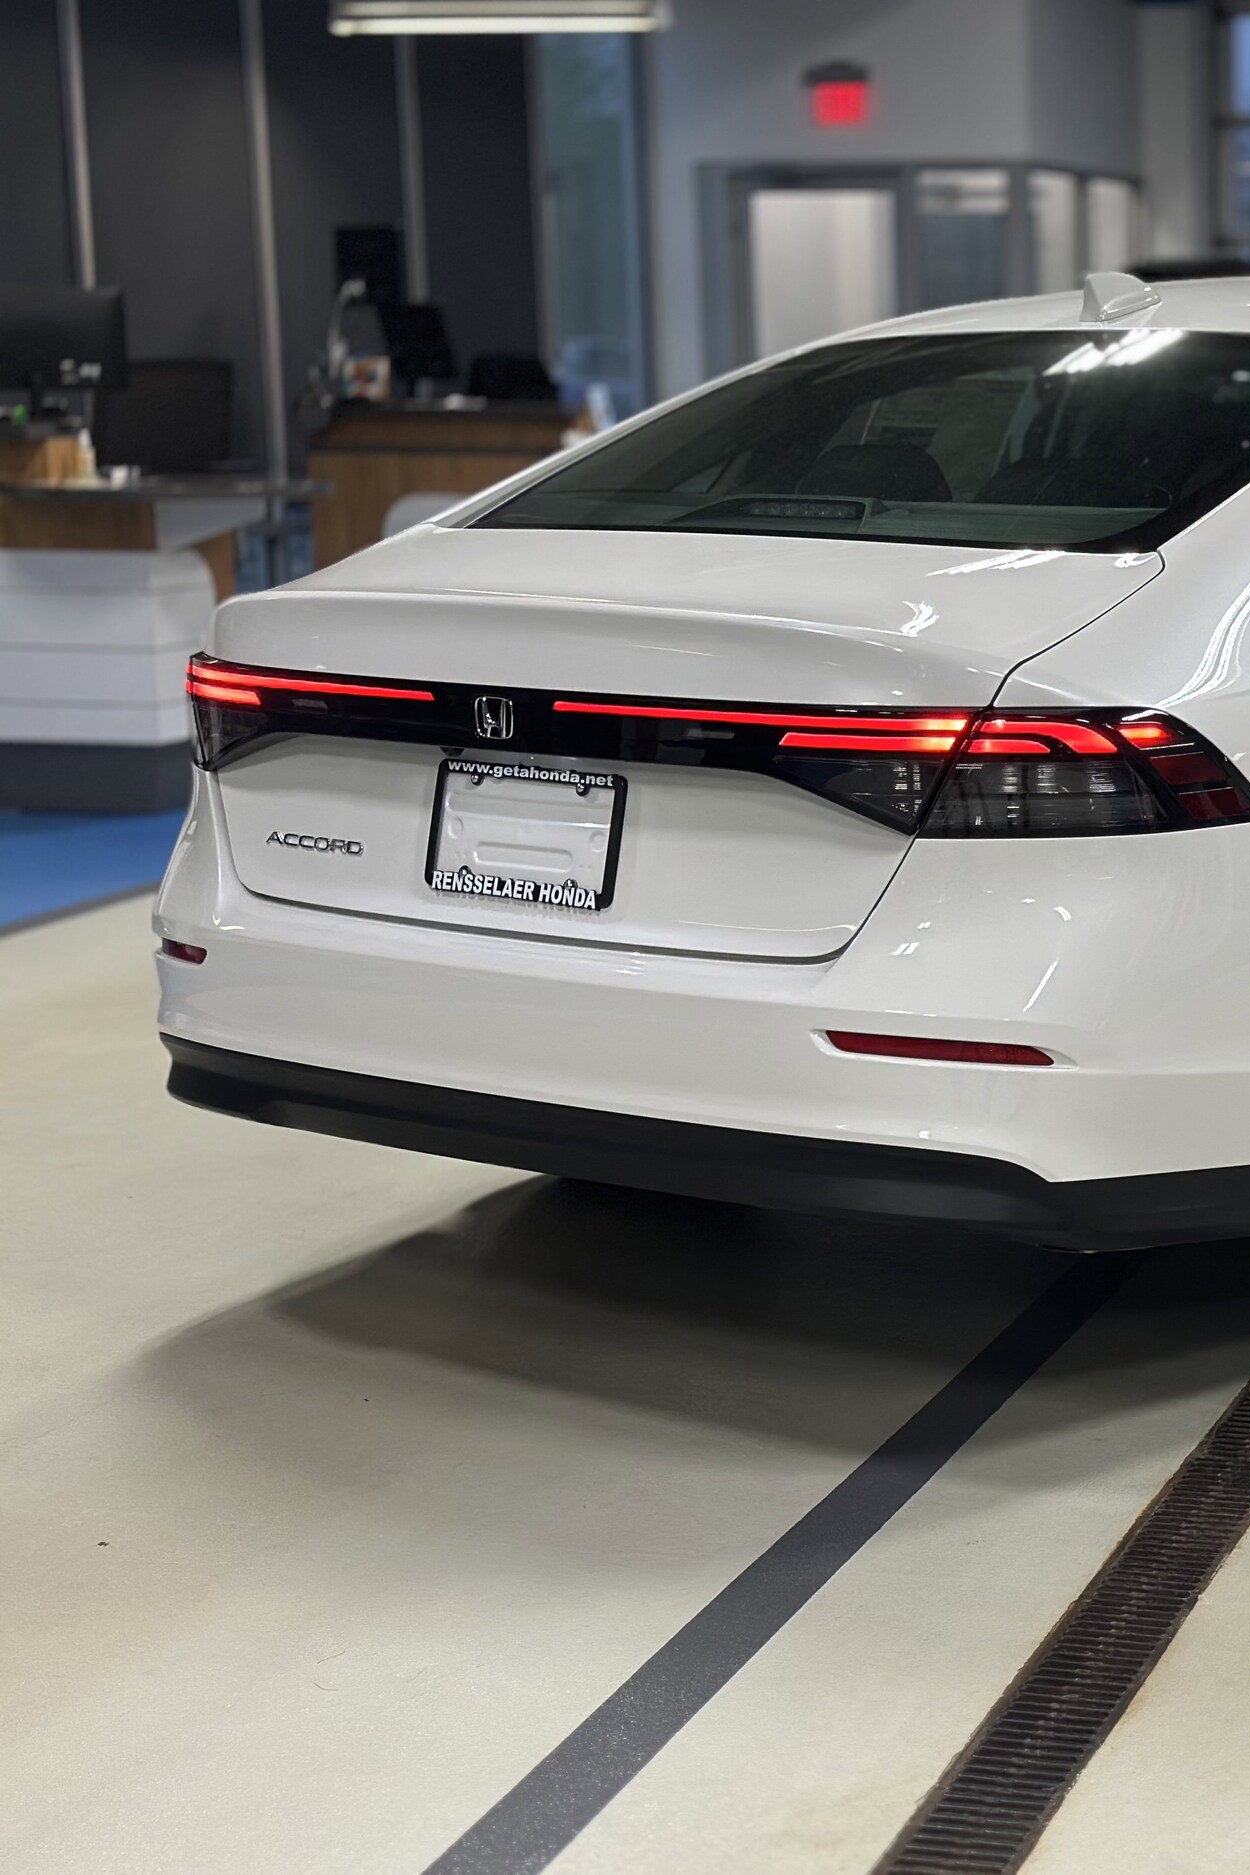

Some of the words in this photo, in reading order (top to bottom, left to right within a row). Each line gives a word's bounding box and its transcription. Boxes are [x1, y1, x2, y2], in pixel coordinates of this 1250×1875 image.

[448, 760, 614, 787] www.getahonda.net
[266, 831, 364, 855] ACCORD
[431, 870, 535, 901] RENSSELAER
[539, 883, 597, 910] HONDA
